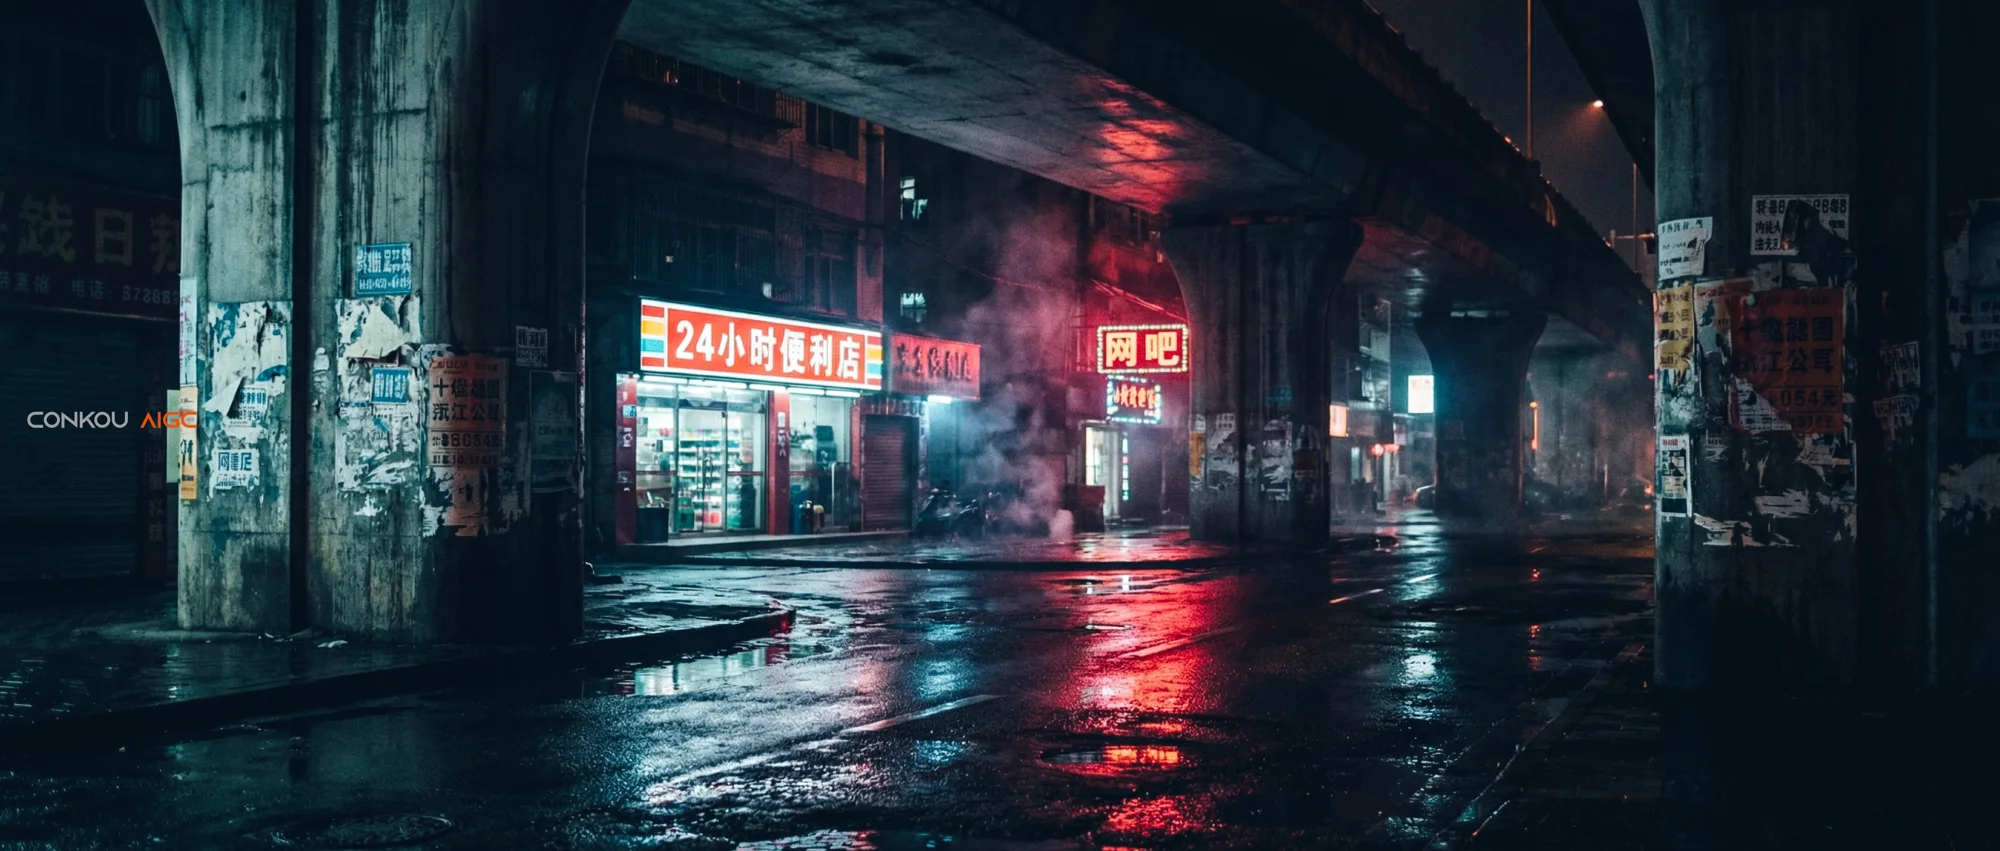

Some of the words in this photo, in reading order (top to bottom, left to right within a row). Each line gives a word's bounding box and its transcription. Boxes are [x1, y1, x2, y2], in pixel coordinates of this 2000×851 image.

[674, 319, 859, 380] 24小时便利店
[1105, 331, 1180, 367] 网吧
